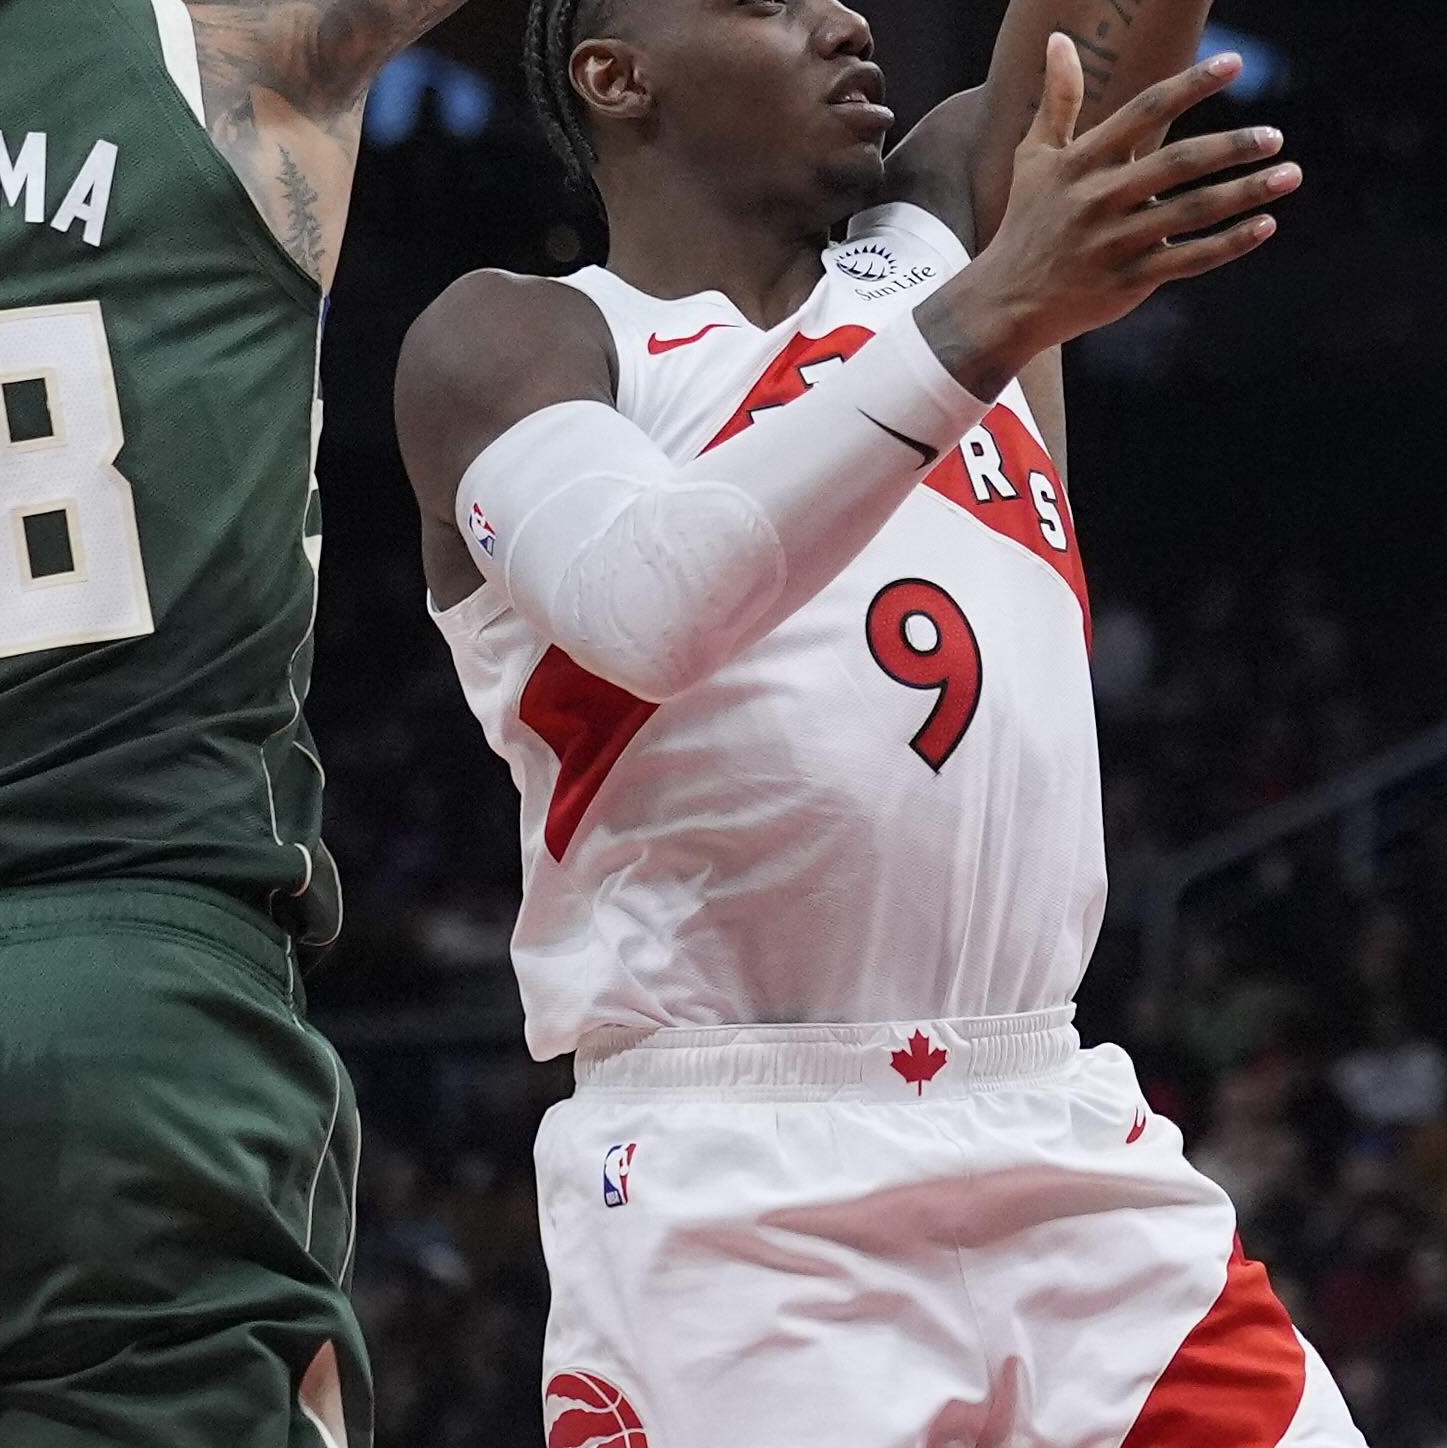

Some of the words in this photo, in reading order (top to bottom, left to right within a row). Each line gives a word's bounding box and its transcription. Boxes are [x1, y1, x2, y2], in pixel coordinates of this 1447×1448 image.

[854, 285, 897, 302] Sun
[891, 265, 937, 291] Life
[865, 577, 983, 776] 9
